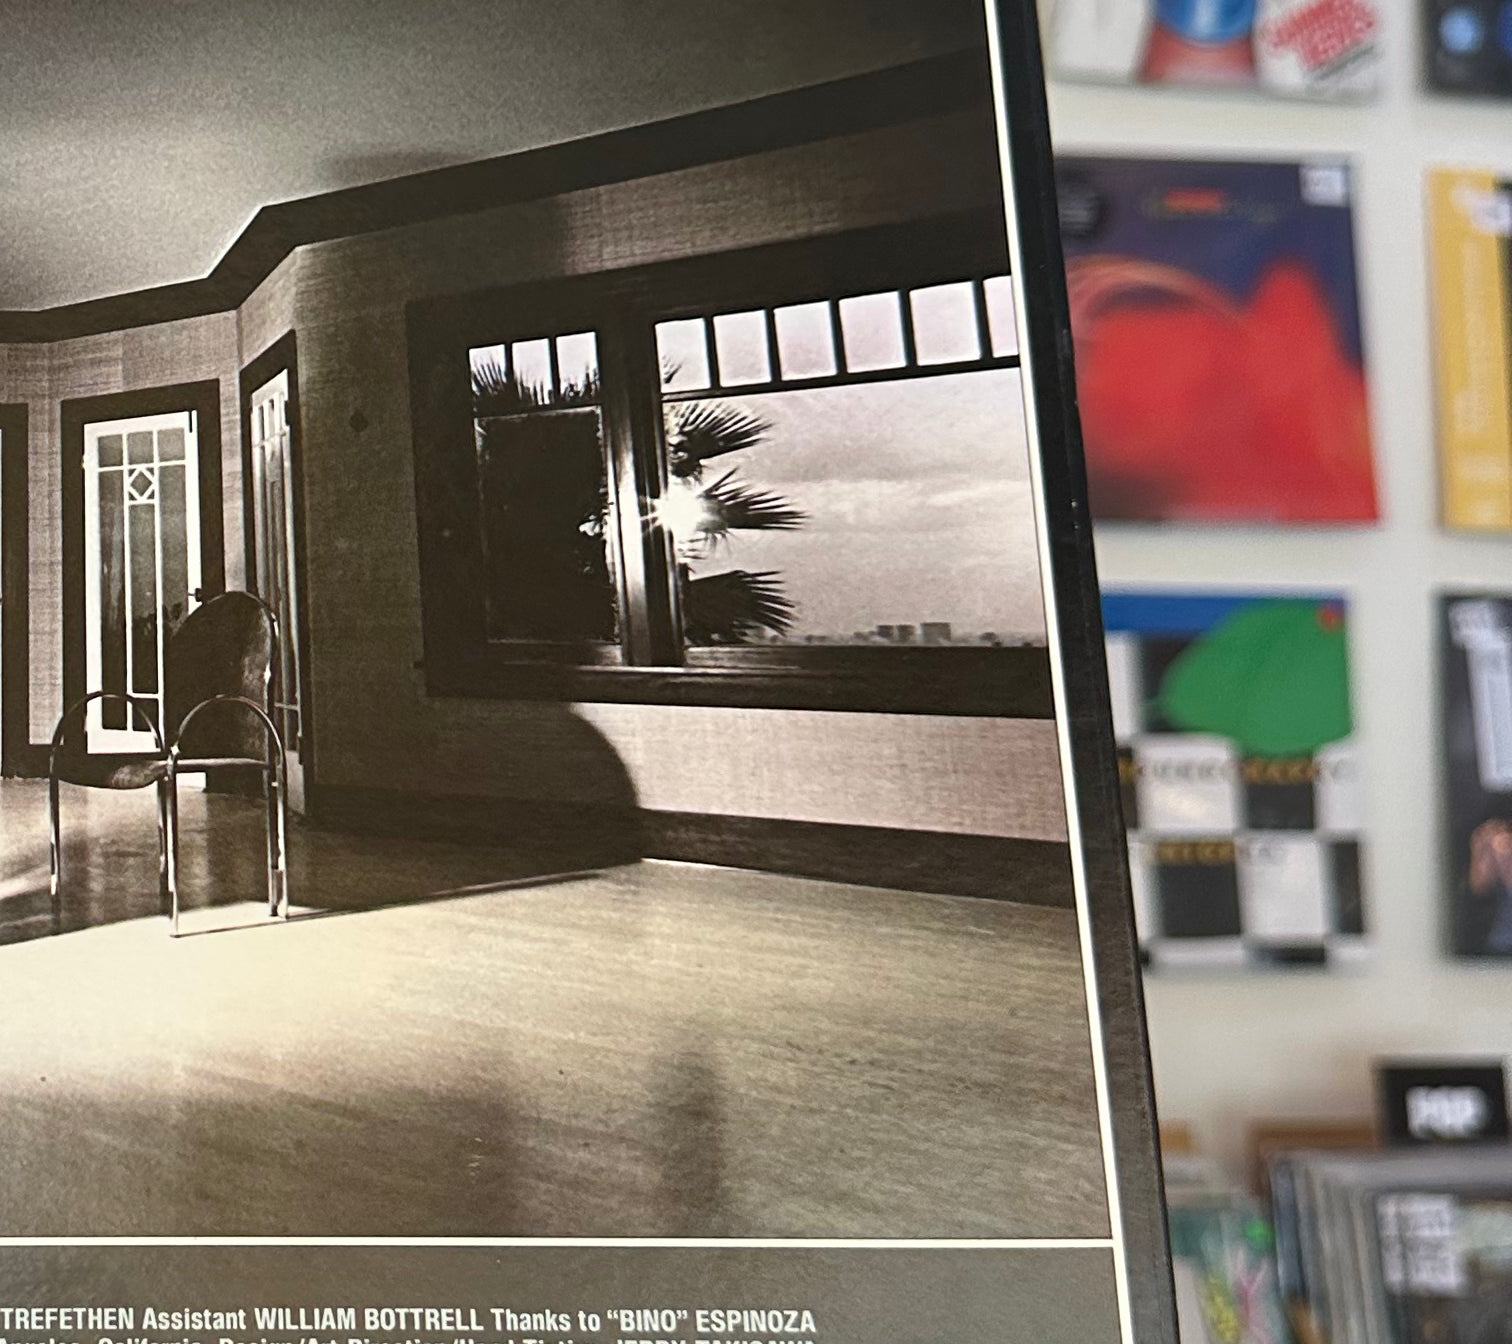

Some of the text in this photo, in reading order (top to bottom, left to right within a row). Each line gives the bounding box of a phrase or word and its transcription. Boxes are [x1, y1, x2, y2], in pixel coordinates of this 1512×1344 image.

[0, 1307, 134, 1331] TREFETHEN
[142, 1307, 247, 1330] Assistant
[254, 1307, 356, 1331] WILLIAM
[364, 1308, 485, 1331] BOTTRELL
[489, 1308, 572, 1332] Thanks
[577, 1309, 601, 1332] to
[695, 1310, 817, 1334] ESPINOZA
